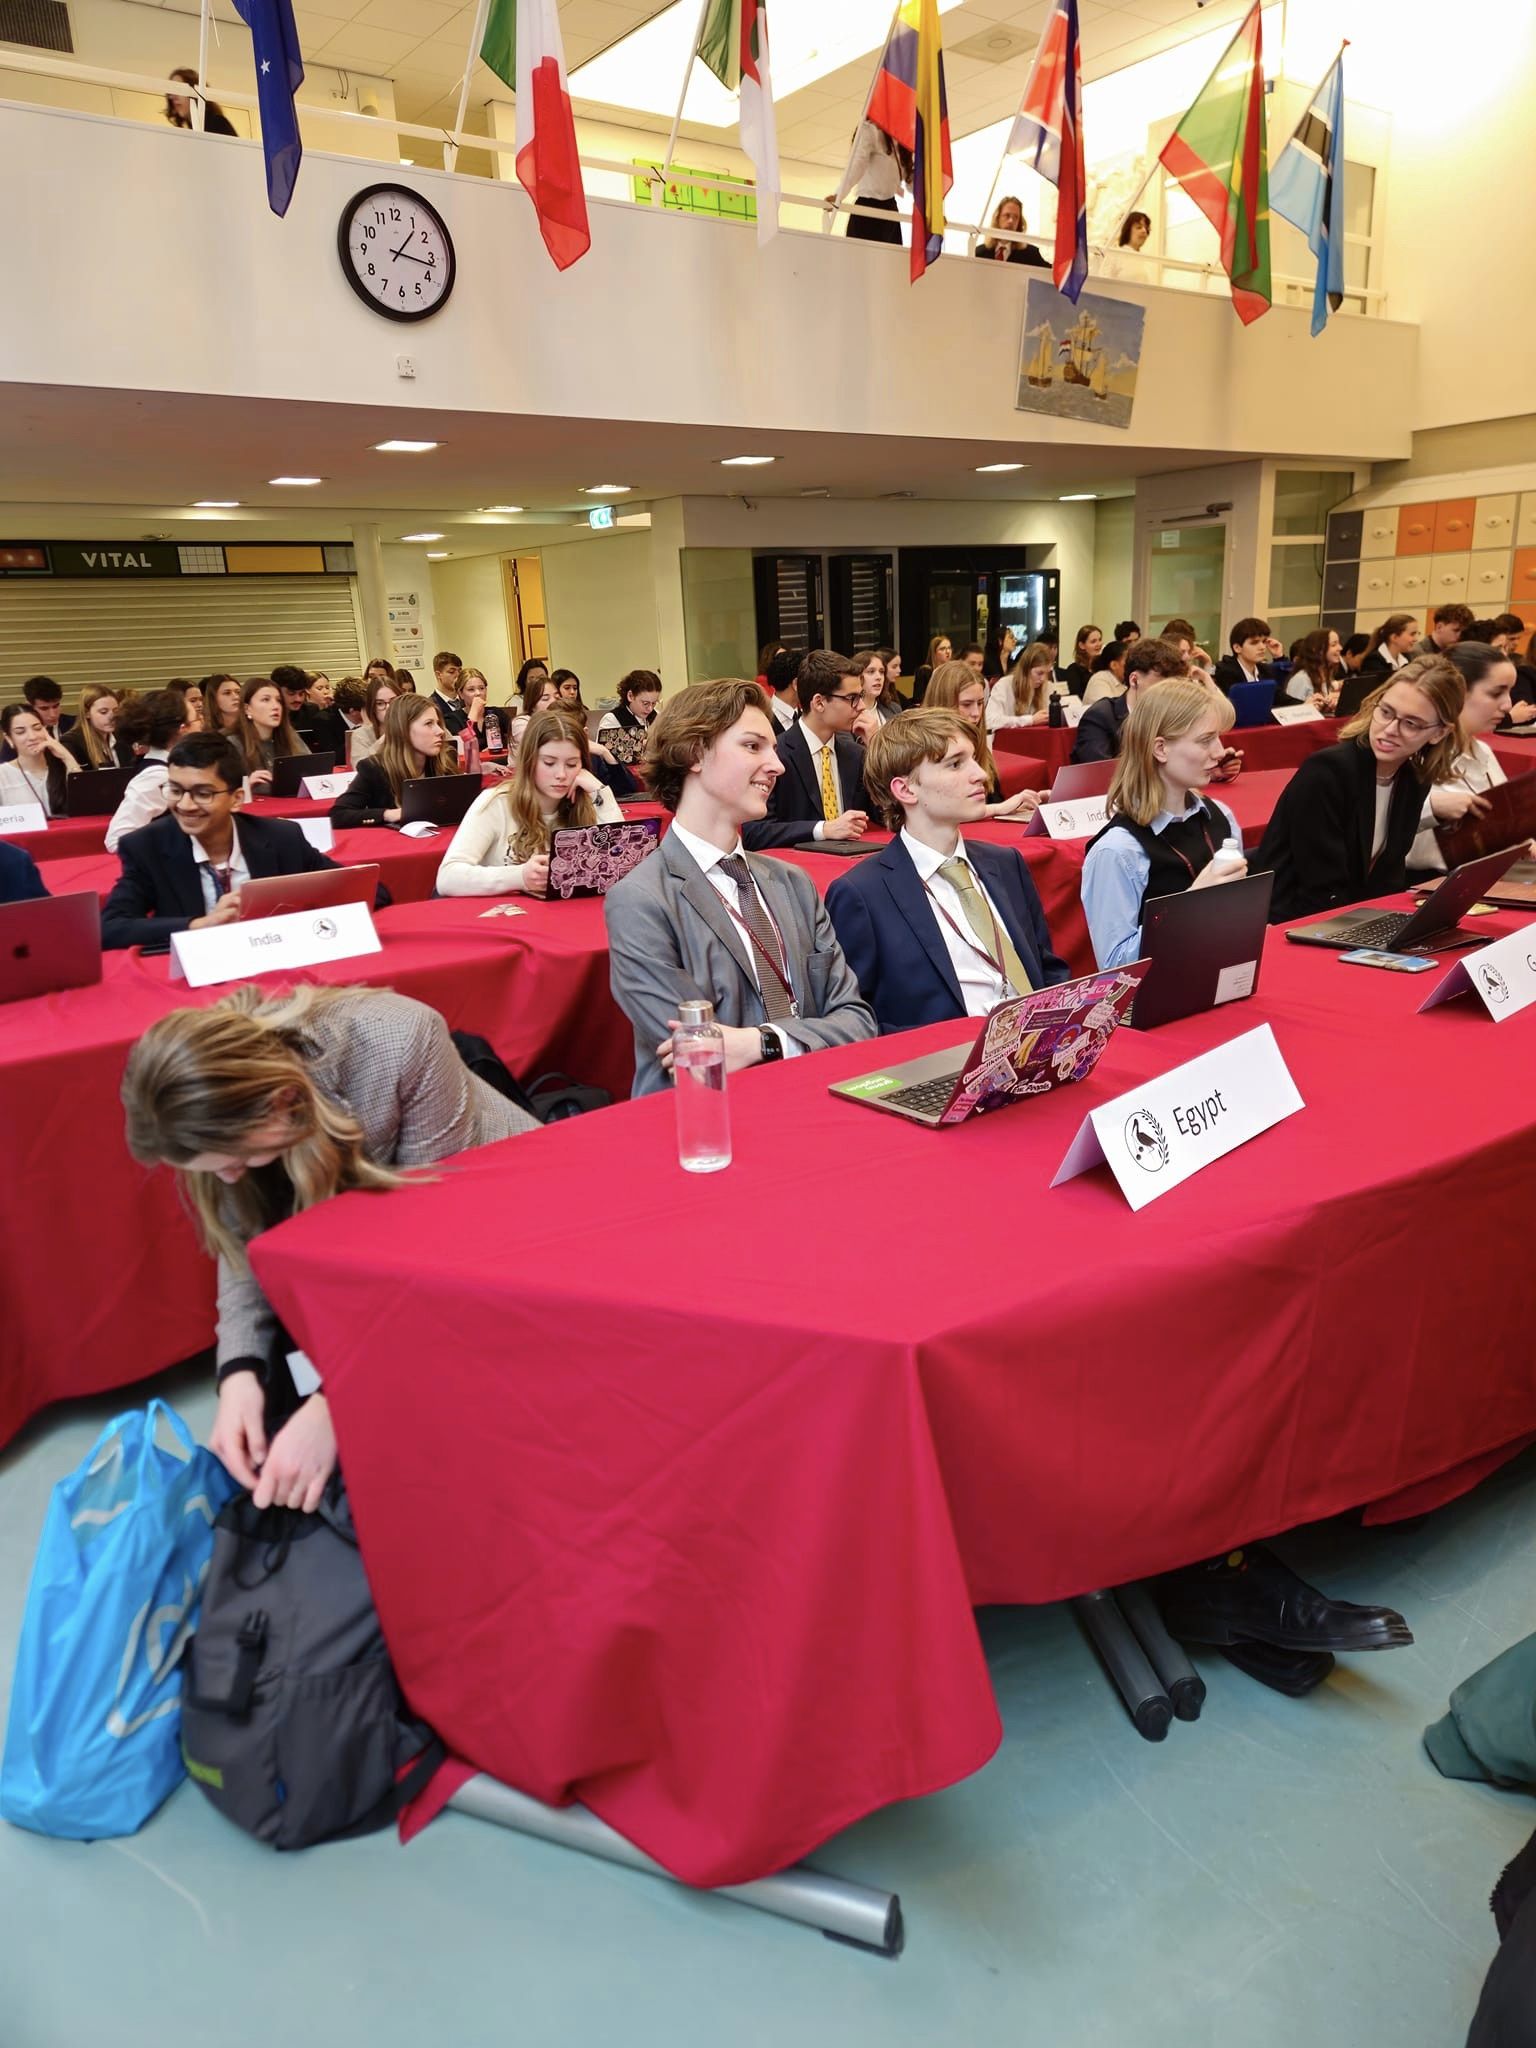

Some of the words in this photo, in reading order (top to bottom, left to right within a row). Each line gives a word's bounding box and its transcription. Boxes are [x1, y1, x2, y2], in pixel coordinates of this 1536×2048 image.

[375, 212, 386, 225] 11
[389, 208, 401, 221] 12
[363, 226, 376, 239] 10
[421, 231, 429, 244] 2
[360, 243, 367, 255] 9
[428, 252, 435, 265] 3
[368, 263, 375, 275] 8
[424, 270, 431, 282] 4
[381, 279, 388, 291] 7
[414, 283, 421, 295] 5
[399, 286, 405, 298] 6
[81, 552, 152, 568] VITAL
[248, 932, 283, 947] India
[1172, 1089, 1227, 1136] Egypt
